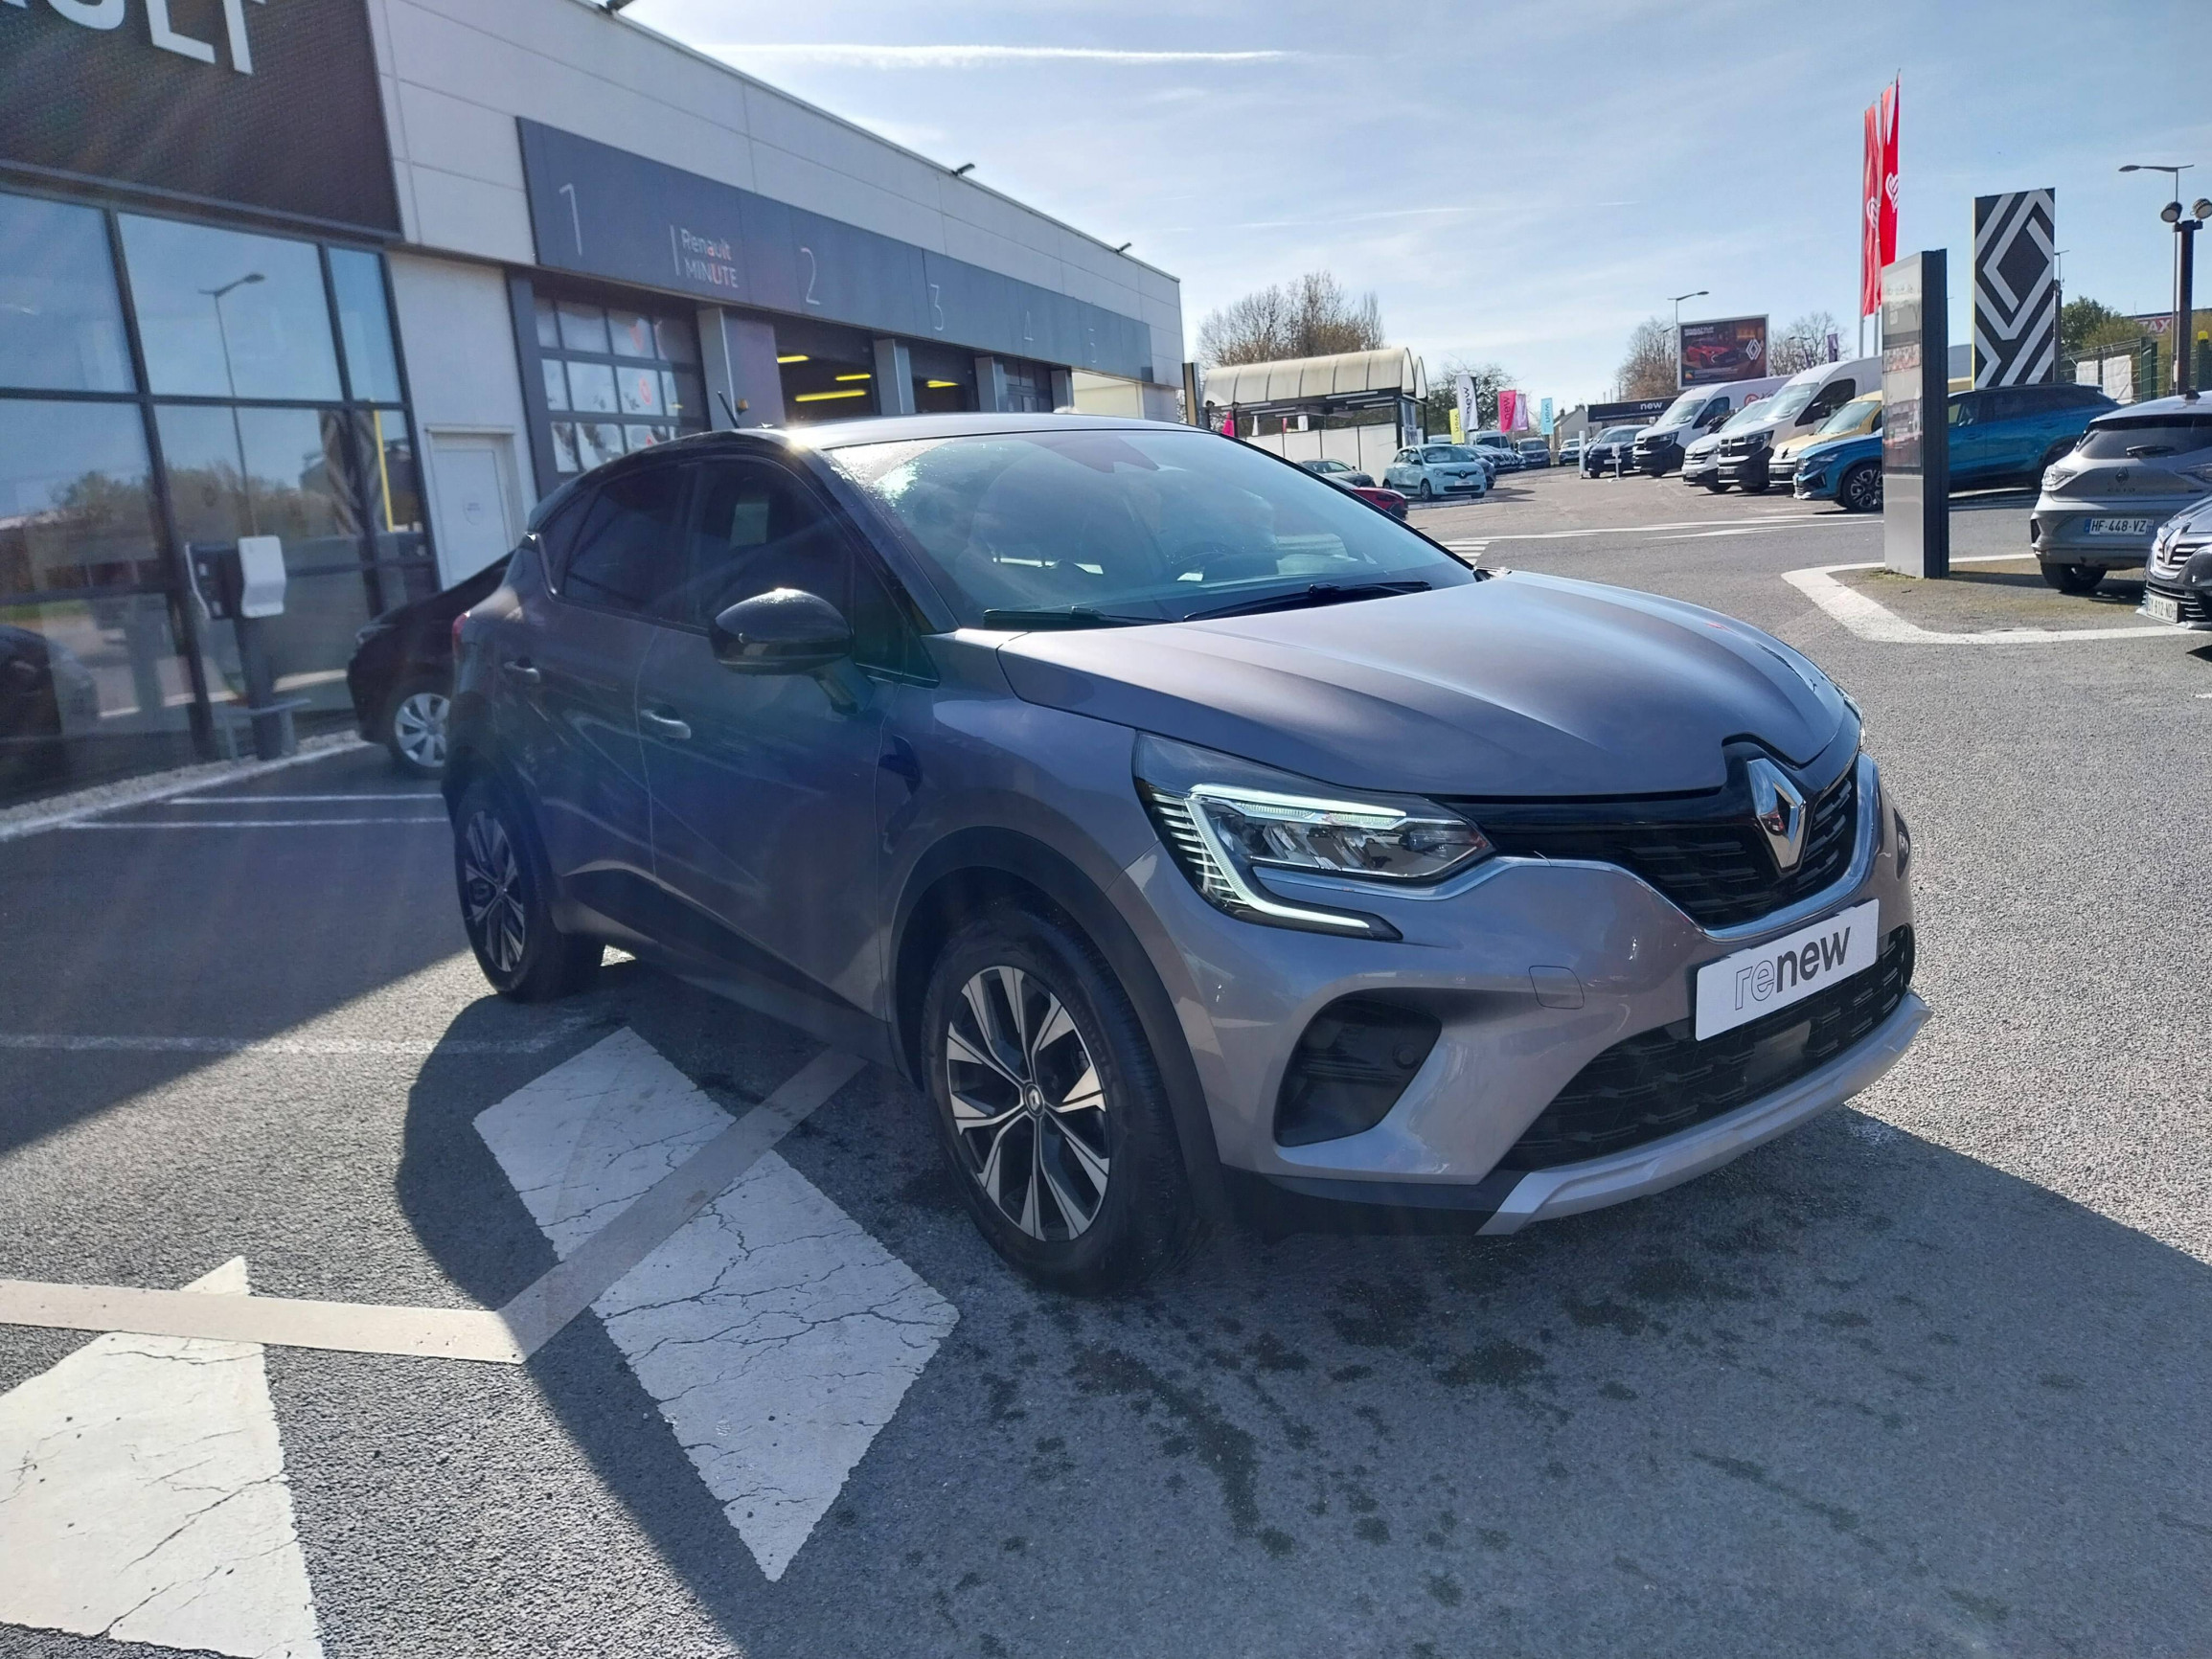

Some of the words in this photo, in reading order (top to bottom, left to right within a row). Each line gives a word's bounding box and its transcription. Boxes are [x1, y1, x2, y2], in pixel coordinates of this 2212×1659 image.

[559, 183, 582, 257] 1
[680, 228, 732, 261] Renault
[684, 258, 739, 287] MINUTE
[801, 247, 821, 306] 2
[930, 284, 945, 331] 3
[1024, 310, 1034, 342] 4
[1463, 386, 1472, 415] new
[1503, 396, 1512, 420] new
[1640, 401, 1662, 411] new
[2091, 519, 2148, 533] HF-448-VZ
[1735, 926, 1851, 1011] renew
